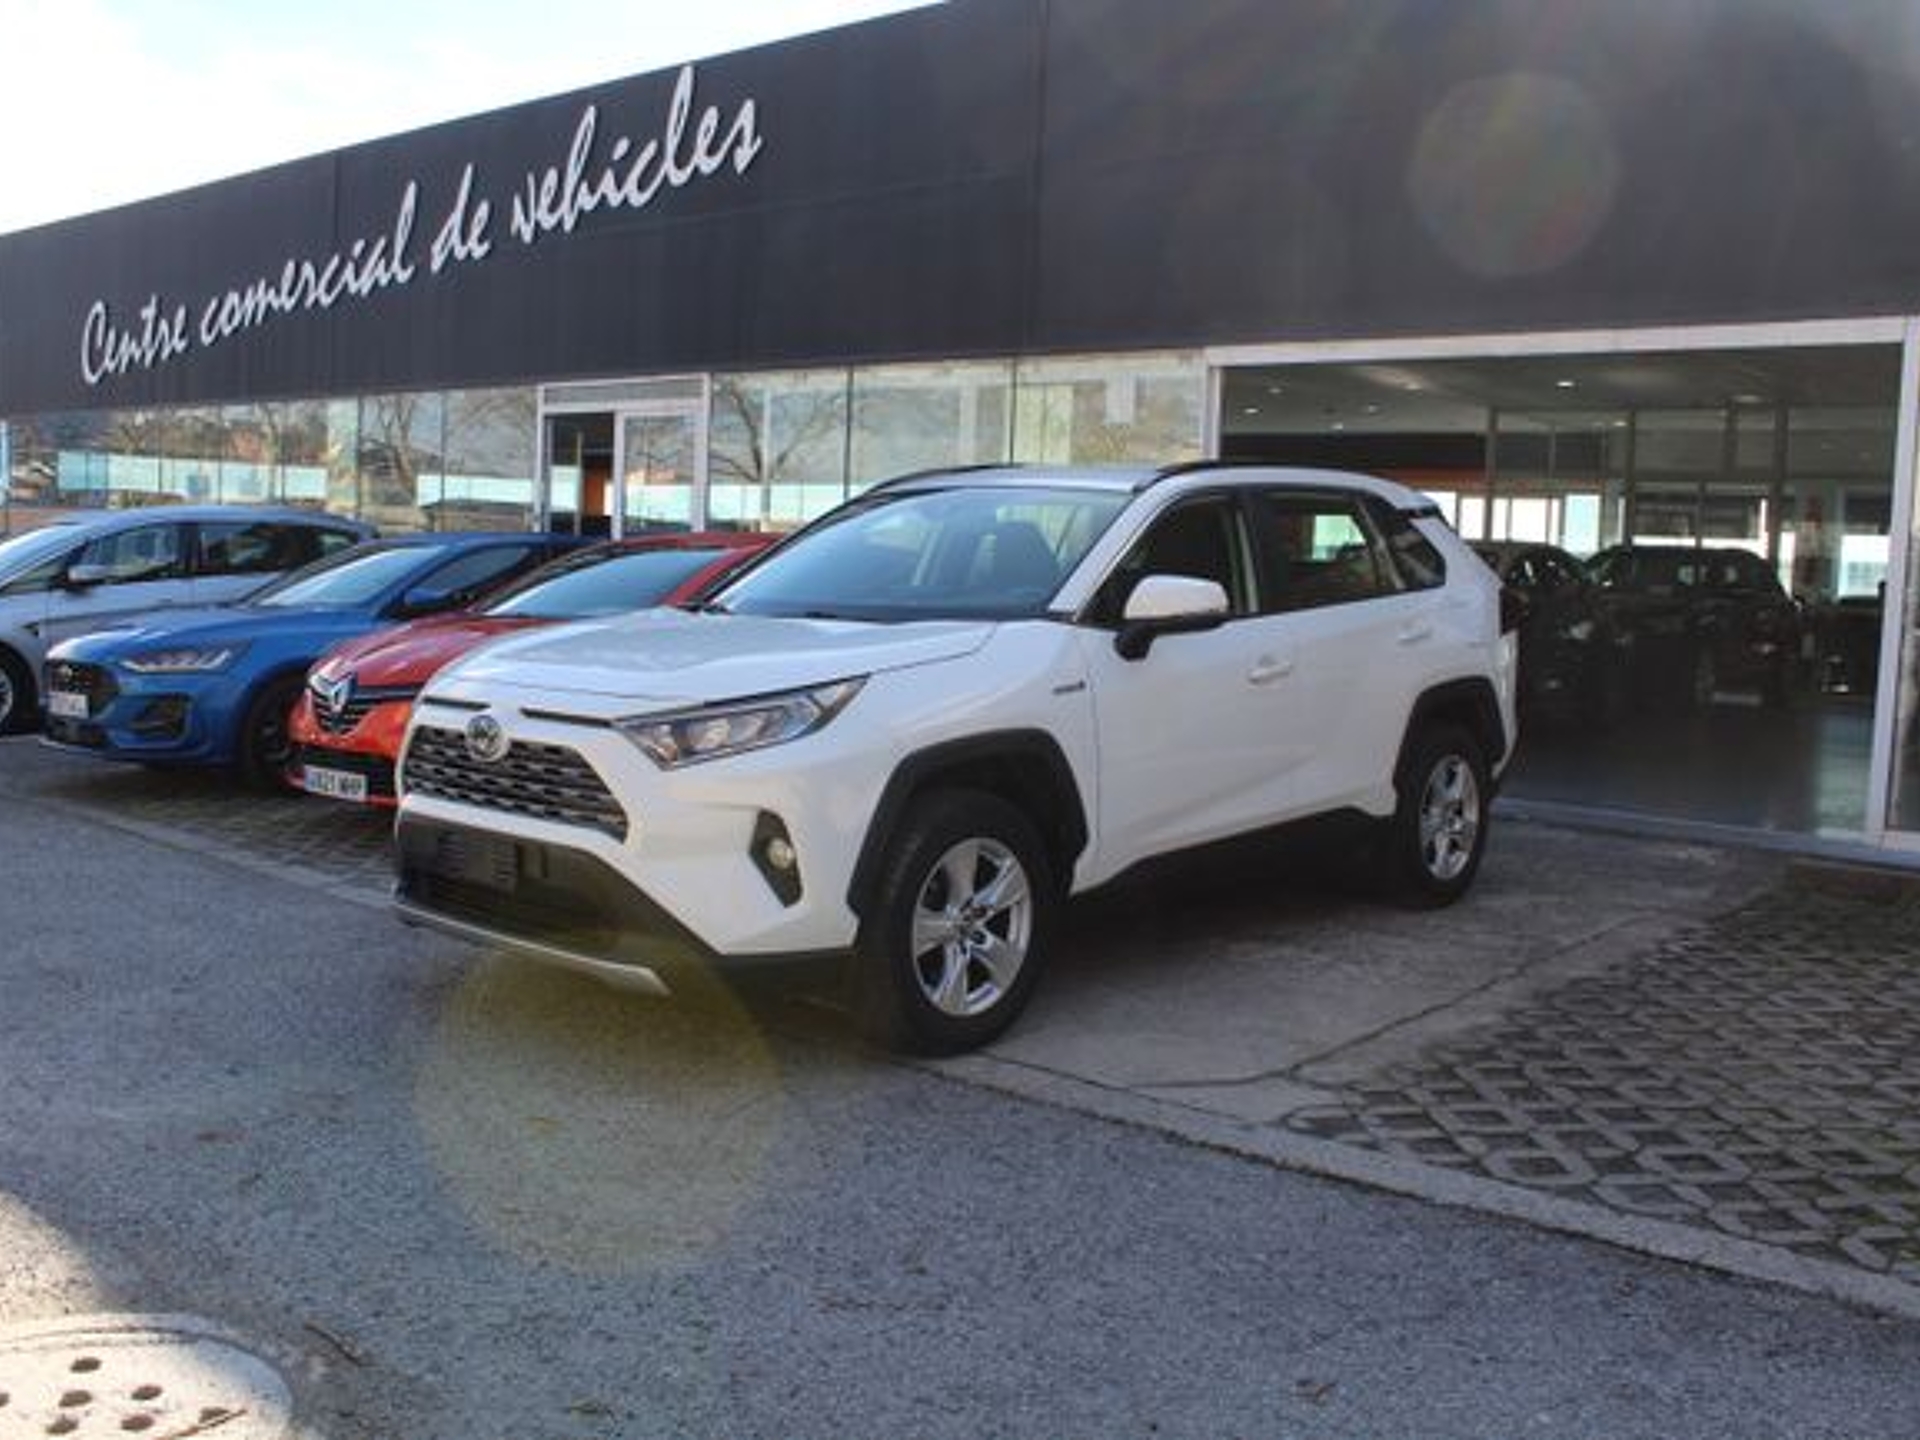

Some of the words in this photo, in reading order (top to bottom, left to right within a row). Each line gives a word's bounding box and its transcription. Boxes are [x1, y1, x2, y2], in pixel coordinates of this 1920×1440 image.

[80, 293, 188, 385] Centre
[199, 180, 417, 347] comercial
[430, 162, 490, 274] de
[510, 63, 763, 245] vehicles
